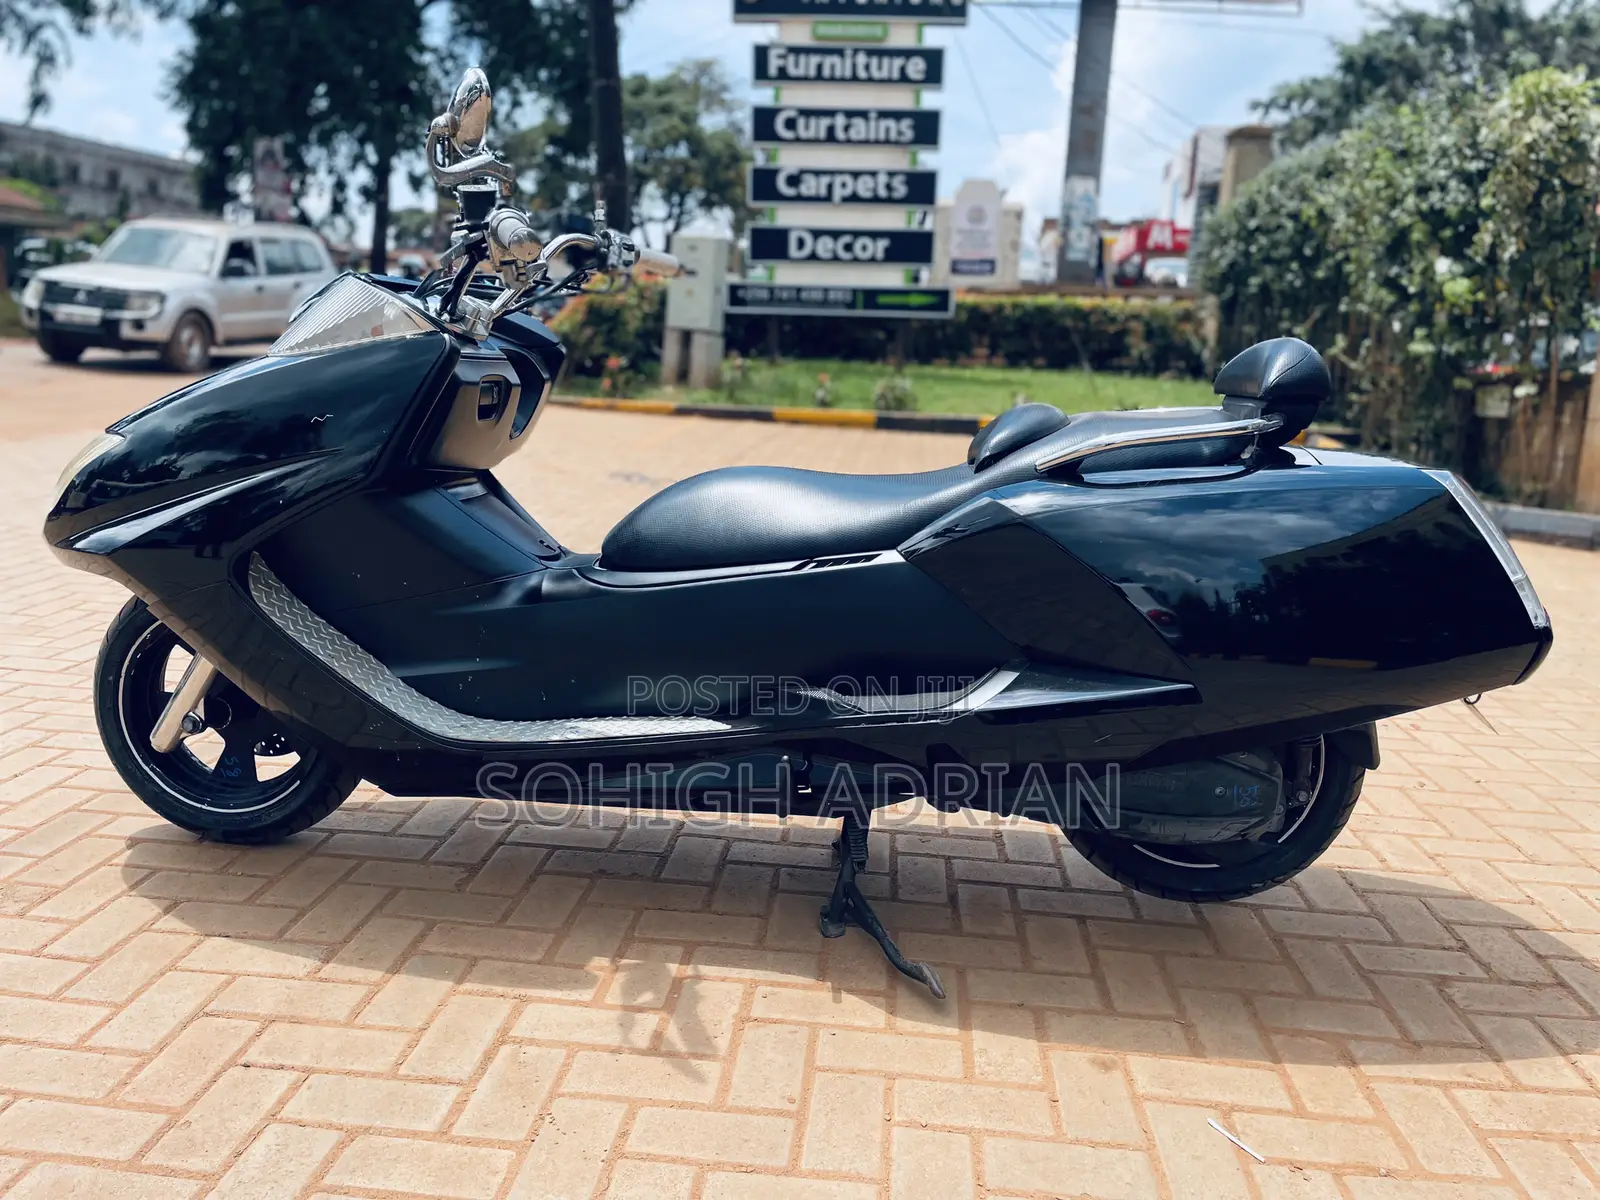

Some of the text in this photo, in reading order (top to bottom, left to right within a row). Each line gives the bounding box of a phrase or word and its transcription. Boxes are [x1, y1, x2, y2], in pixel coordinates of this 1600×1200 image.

[766, 46, 927, 81] Furniture
[774, 110, 915, 143] Curtains
[775, 167, 909, 204] Carpets
[787, 229, 891, 261] Decor
